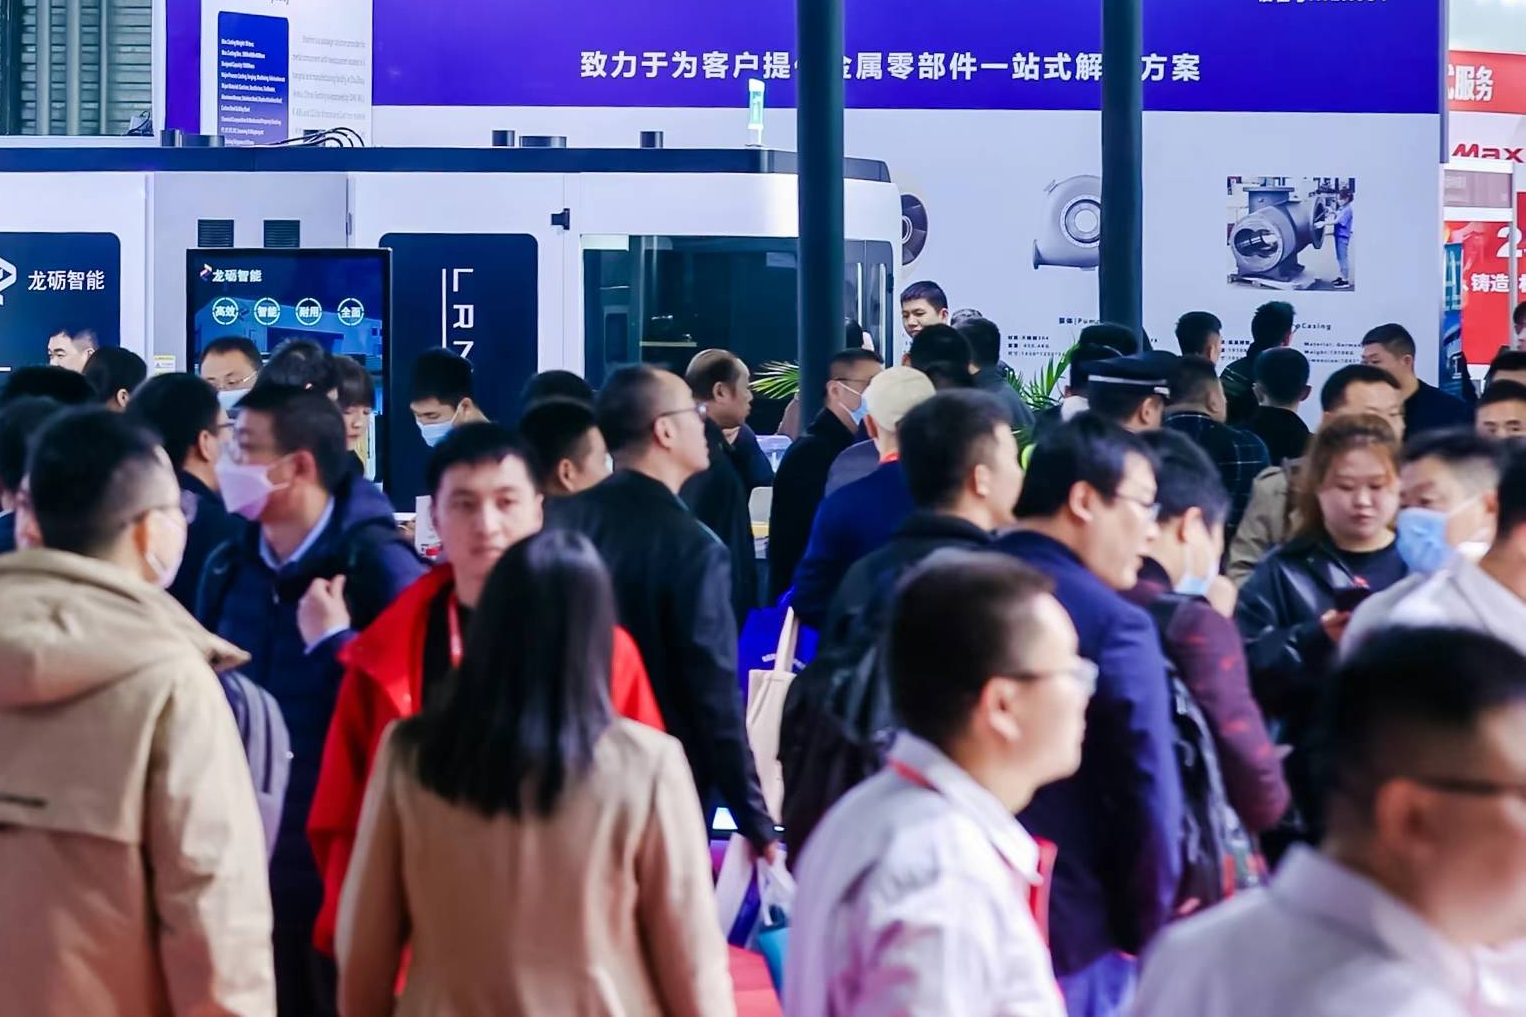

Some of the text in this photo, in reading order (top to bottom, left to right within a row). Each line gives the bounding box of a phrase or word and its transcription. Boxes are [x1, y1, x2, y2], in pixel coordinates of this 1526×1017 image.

[580, 51, 1200, 81] 致力于为客户提属零部件一站式解方案
[1448, 64, 1493, 101] 服务
[28, 270, 105, 290] 龙砺智能
[212, 269, 262, 283] 龙砺智能
[257, 305, 278, 318] 智能
[341, 307, 362, 319] 全面
